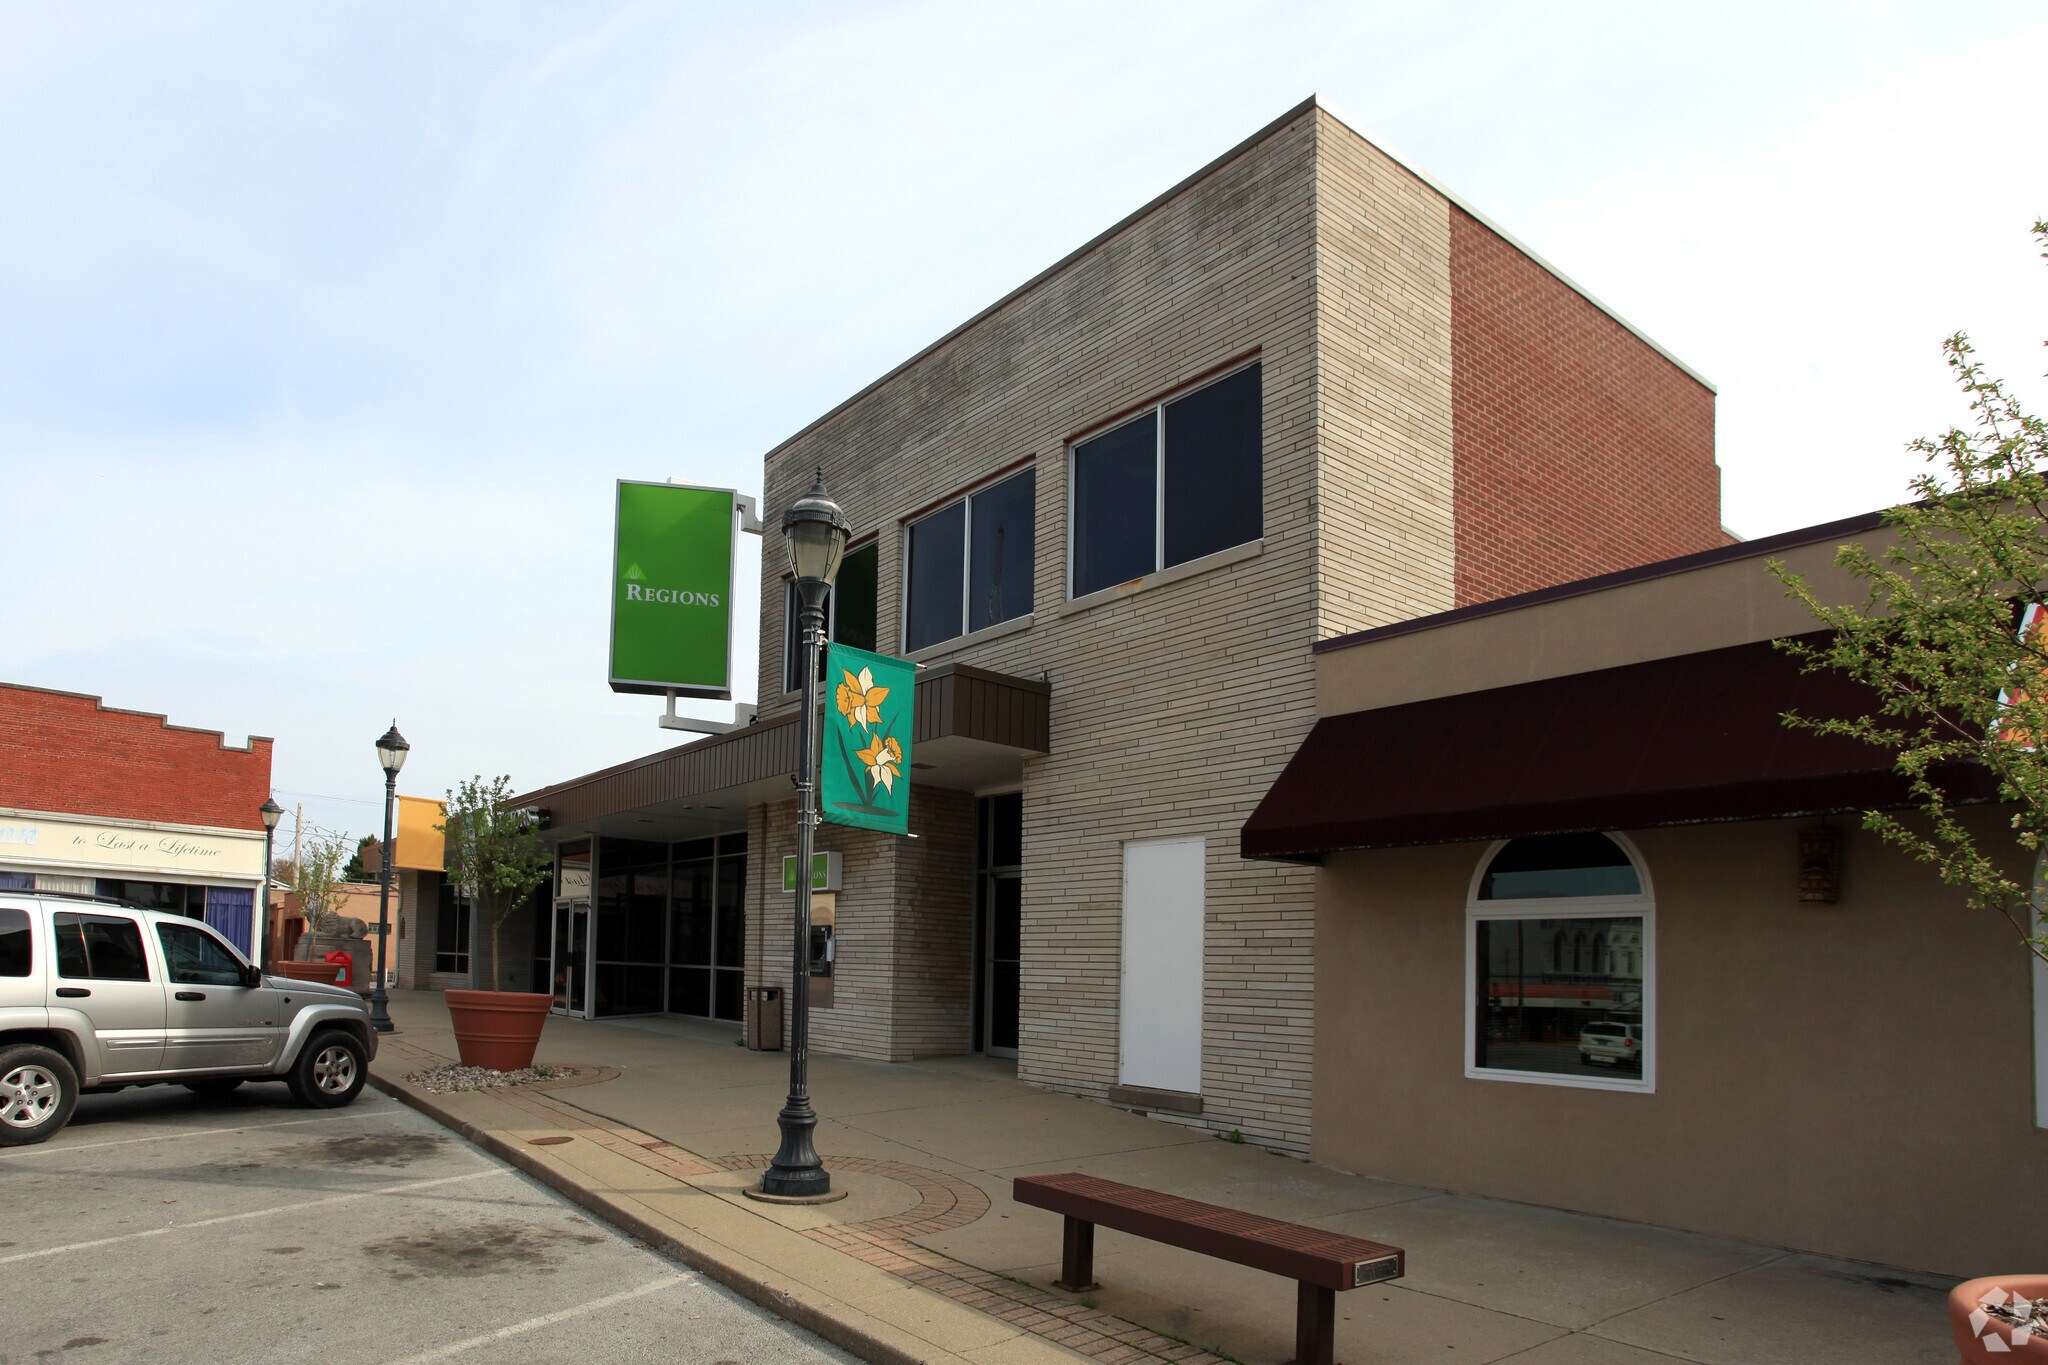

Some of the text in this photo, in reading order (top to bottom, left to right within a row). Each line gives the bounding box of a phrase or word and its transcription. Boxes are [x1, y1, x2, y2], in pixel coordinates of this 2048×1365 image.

[626, 583, 720, 607] REGIONS
[72, 831, 222, 859] to Last a Lifetime
